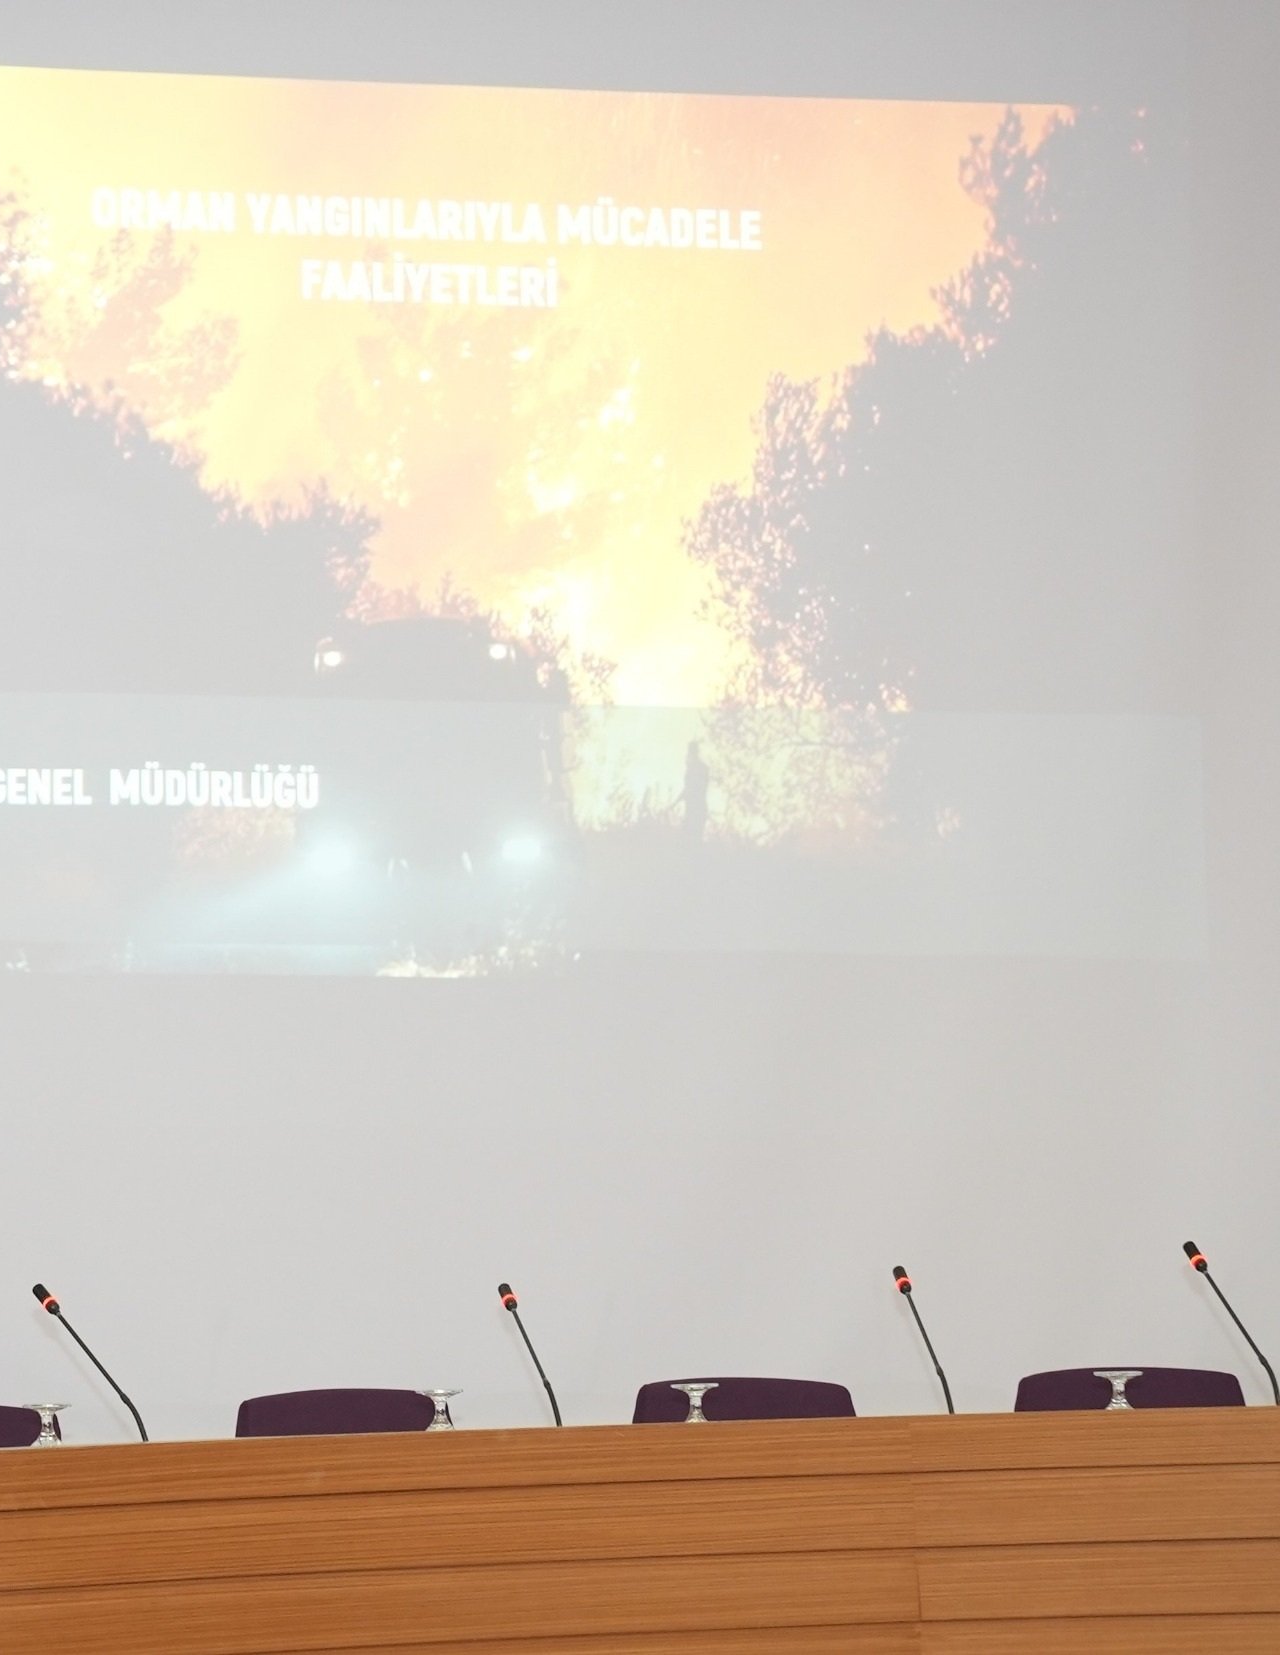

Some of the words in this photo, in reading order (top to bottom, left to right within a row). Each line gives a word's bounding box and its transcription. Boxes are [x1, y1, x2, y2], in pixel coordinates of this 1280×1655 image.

[91, 188, 236, 232] ORMAN
[245, 192, 547, 244] YANGINLARIYLA
[557, 197, 763, 250] MÜCADELE
[300, 256, 559, 308] FAALİYETLERİ
[109, 761, 320, 809] MÜDÜRLÜĞÜ
